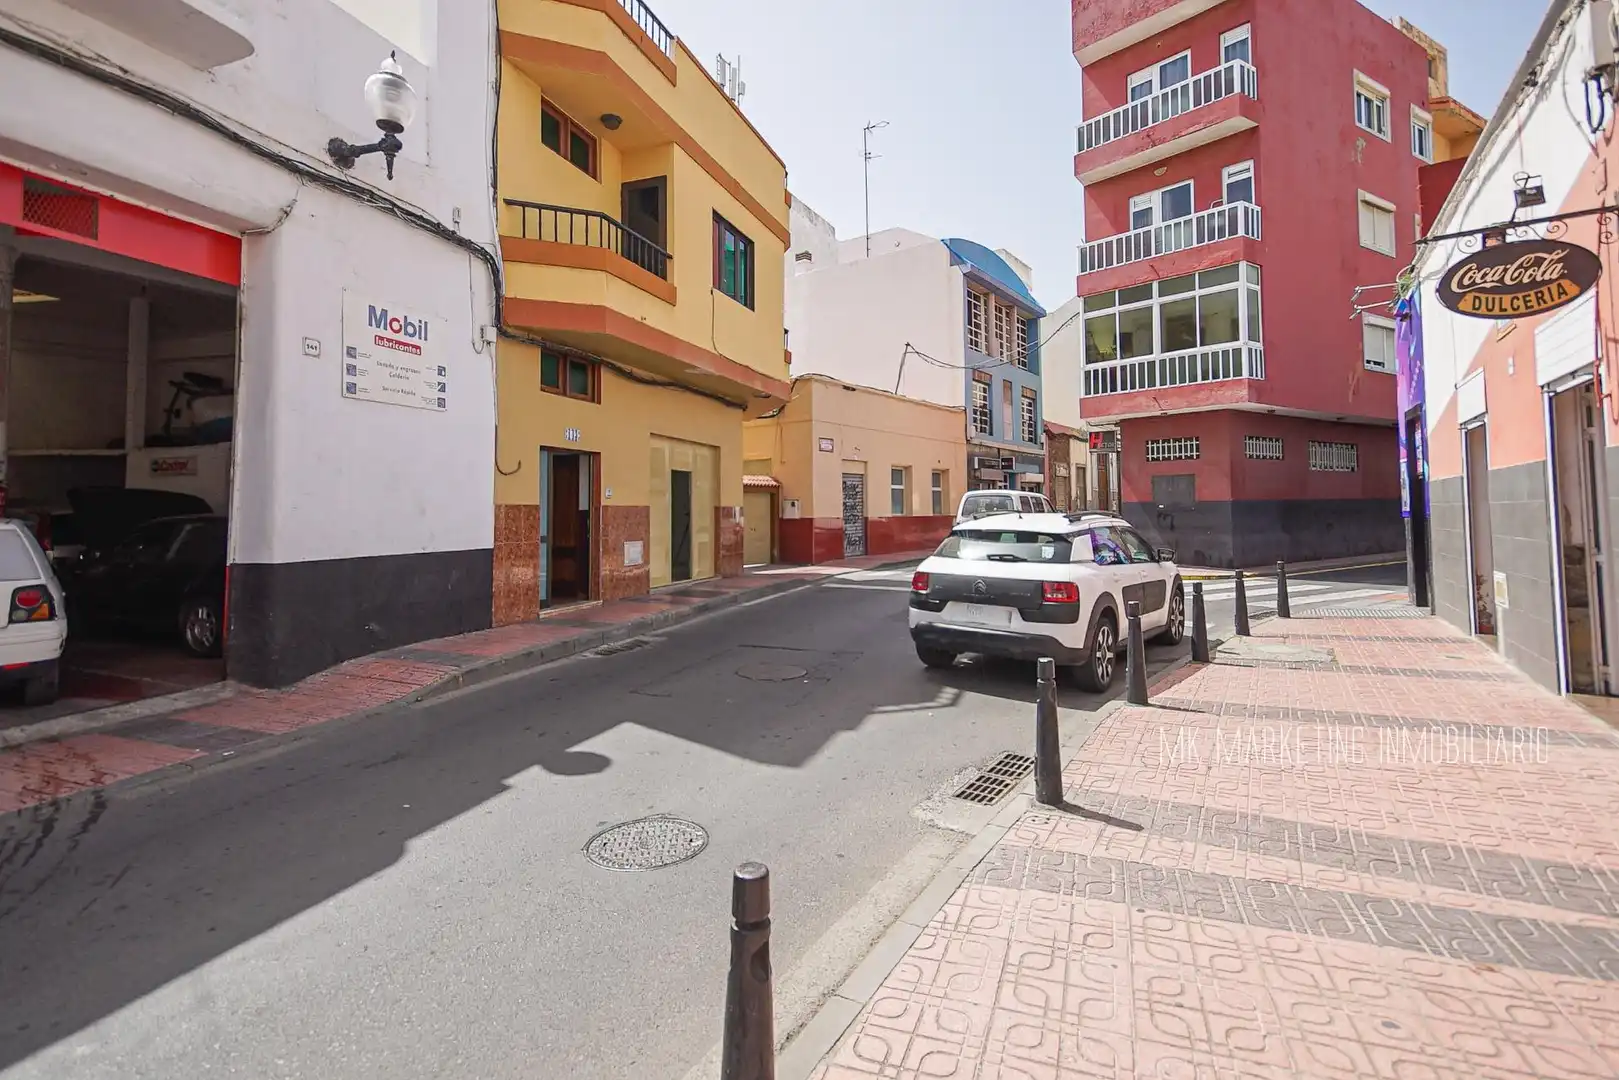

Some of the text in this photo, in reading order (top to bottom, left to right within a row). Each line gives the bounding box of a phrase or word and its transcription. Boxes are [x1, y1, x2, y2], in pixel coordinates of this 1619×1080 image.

[1451, 249, 1569, 293] Coca-Cola
[1472, 282, 1568, 312] DULCERIA
[368, 304, 428, 341] Mobil
[375, 336, 421, 355] lubricantes
